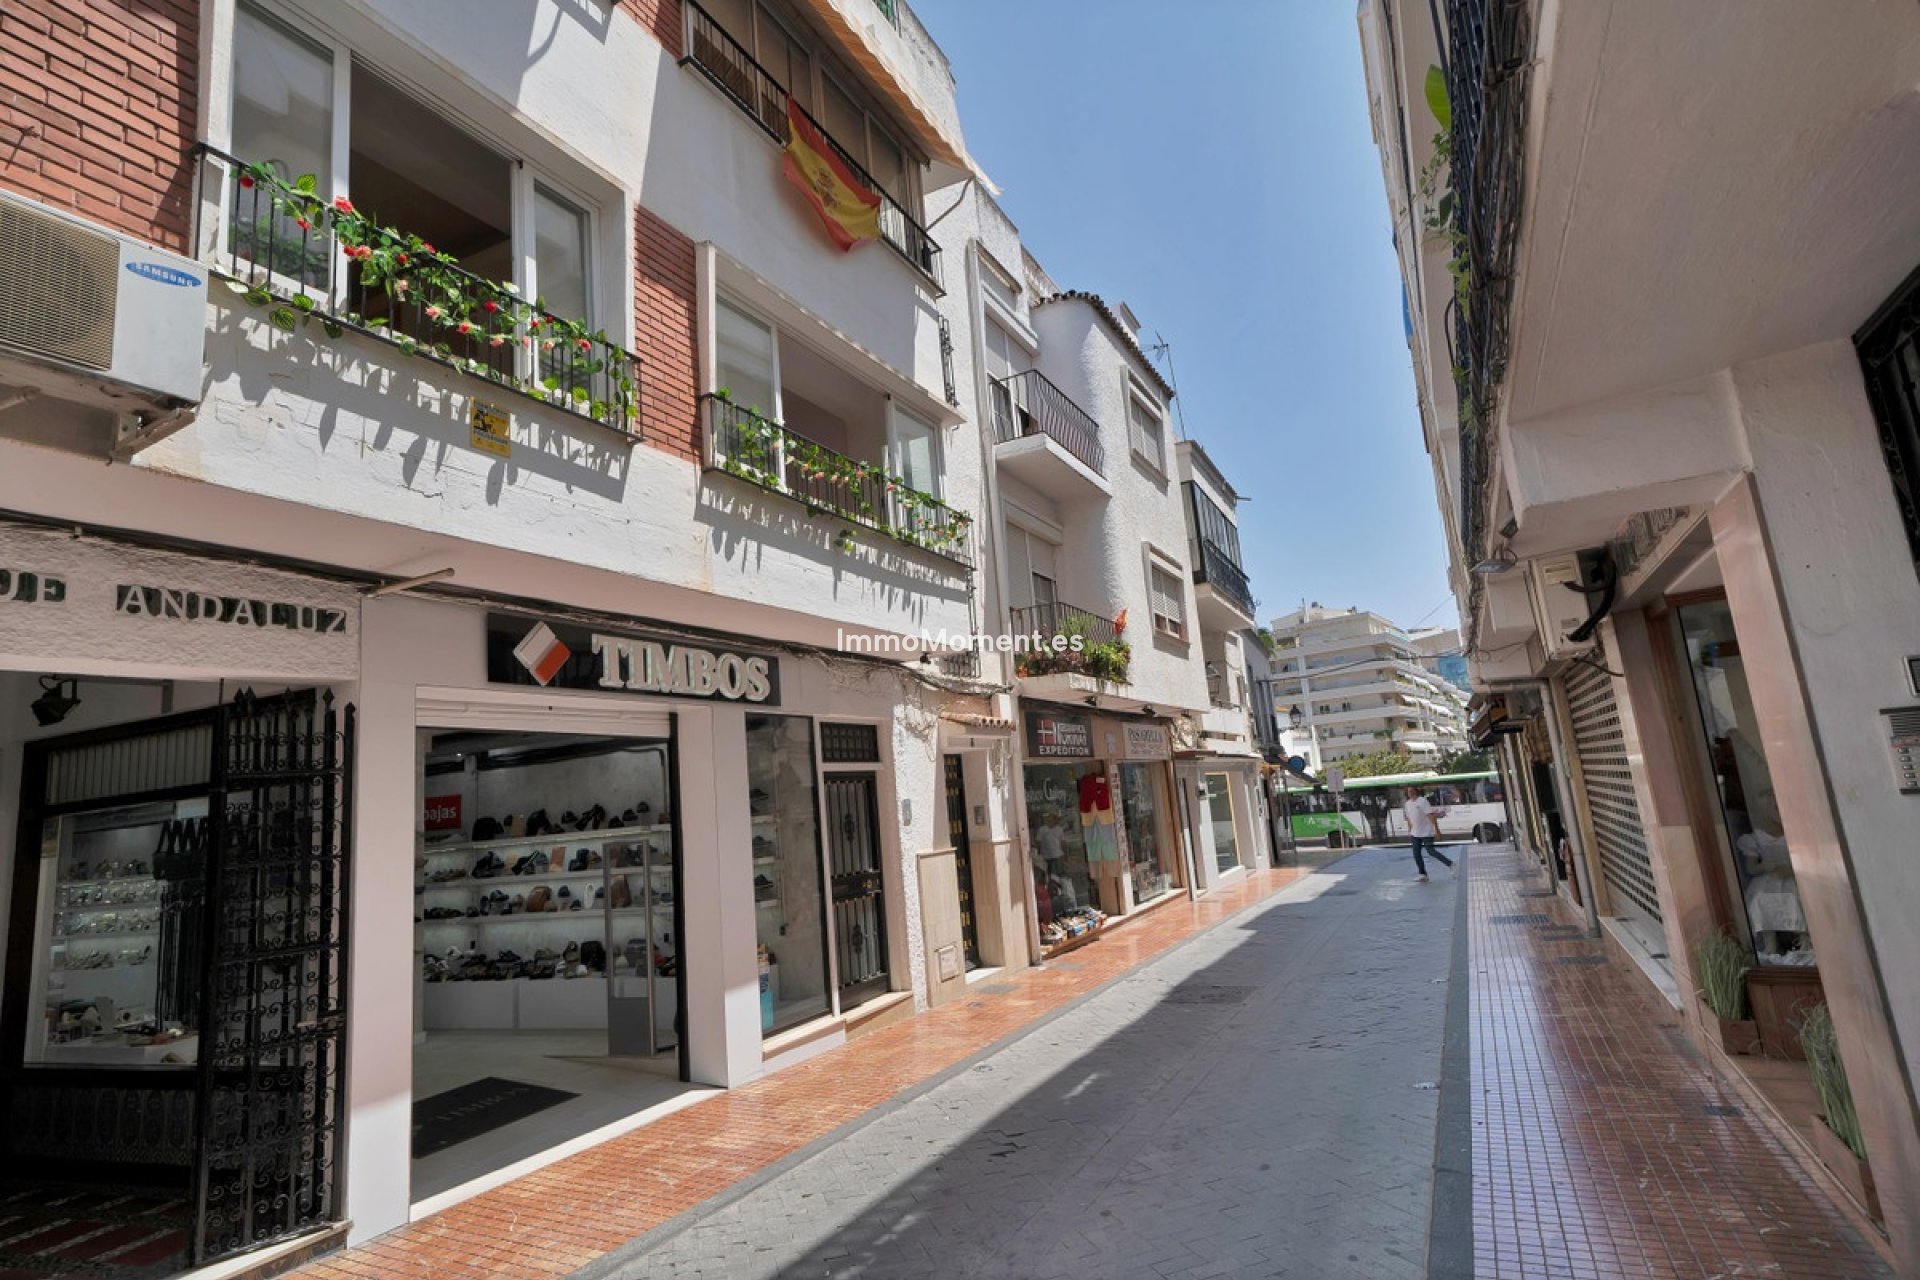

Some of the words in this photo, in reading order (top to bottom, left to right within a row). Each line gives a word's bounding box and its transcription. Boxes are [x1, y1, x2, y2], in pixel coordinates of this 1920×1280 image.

[134, 263, 193, 287] SAMSUNG
[116, 583, 346, 635] ANDALUZ
[591, 633, 771, 702] TIMBOS
[1038, 745, 1090, 756] EXPEDITION
